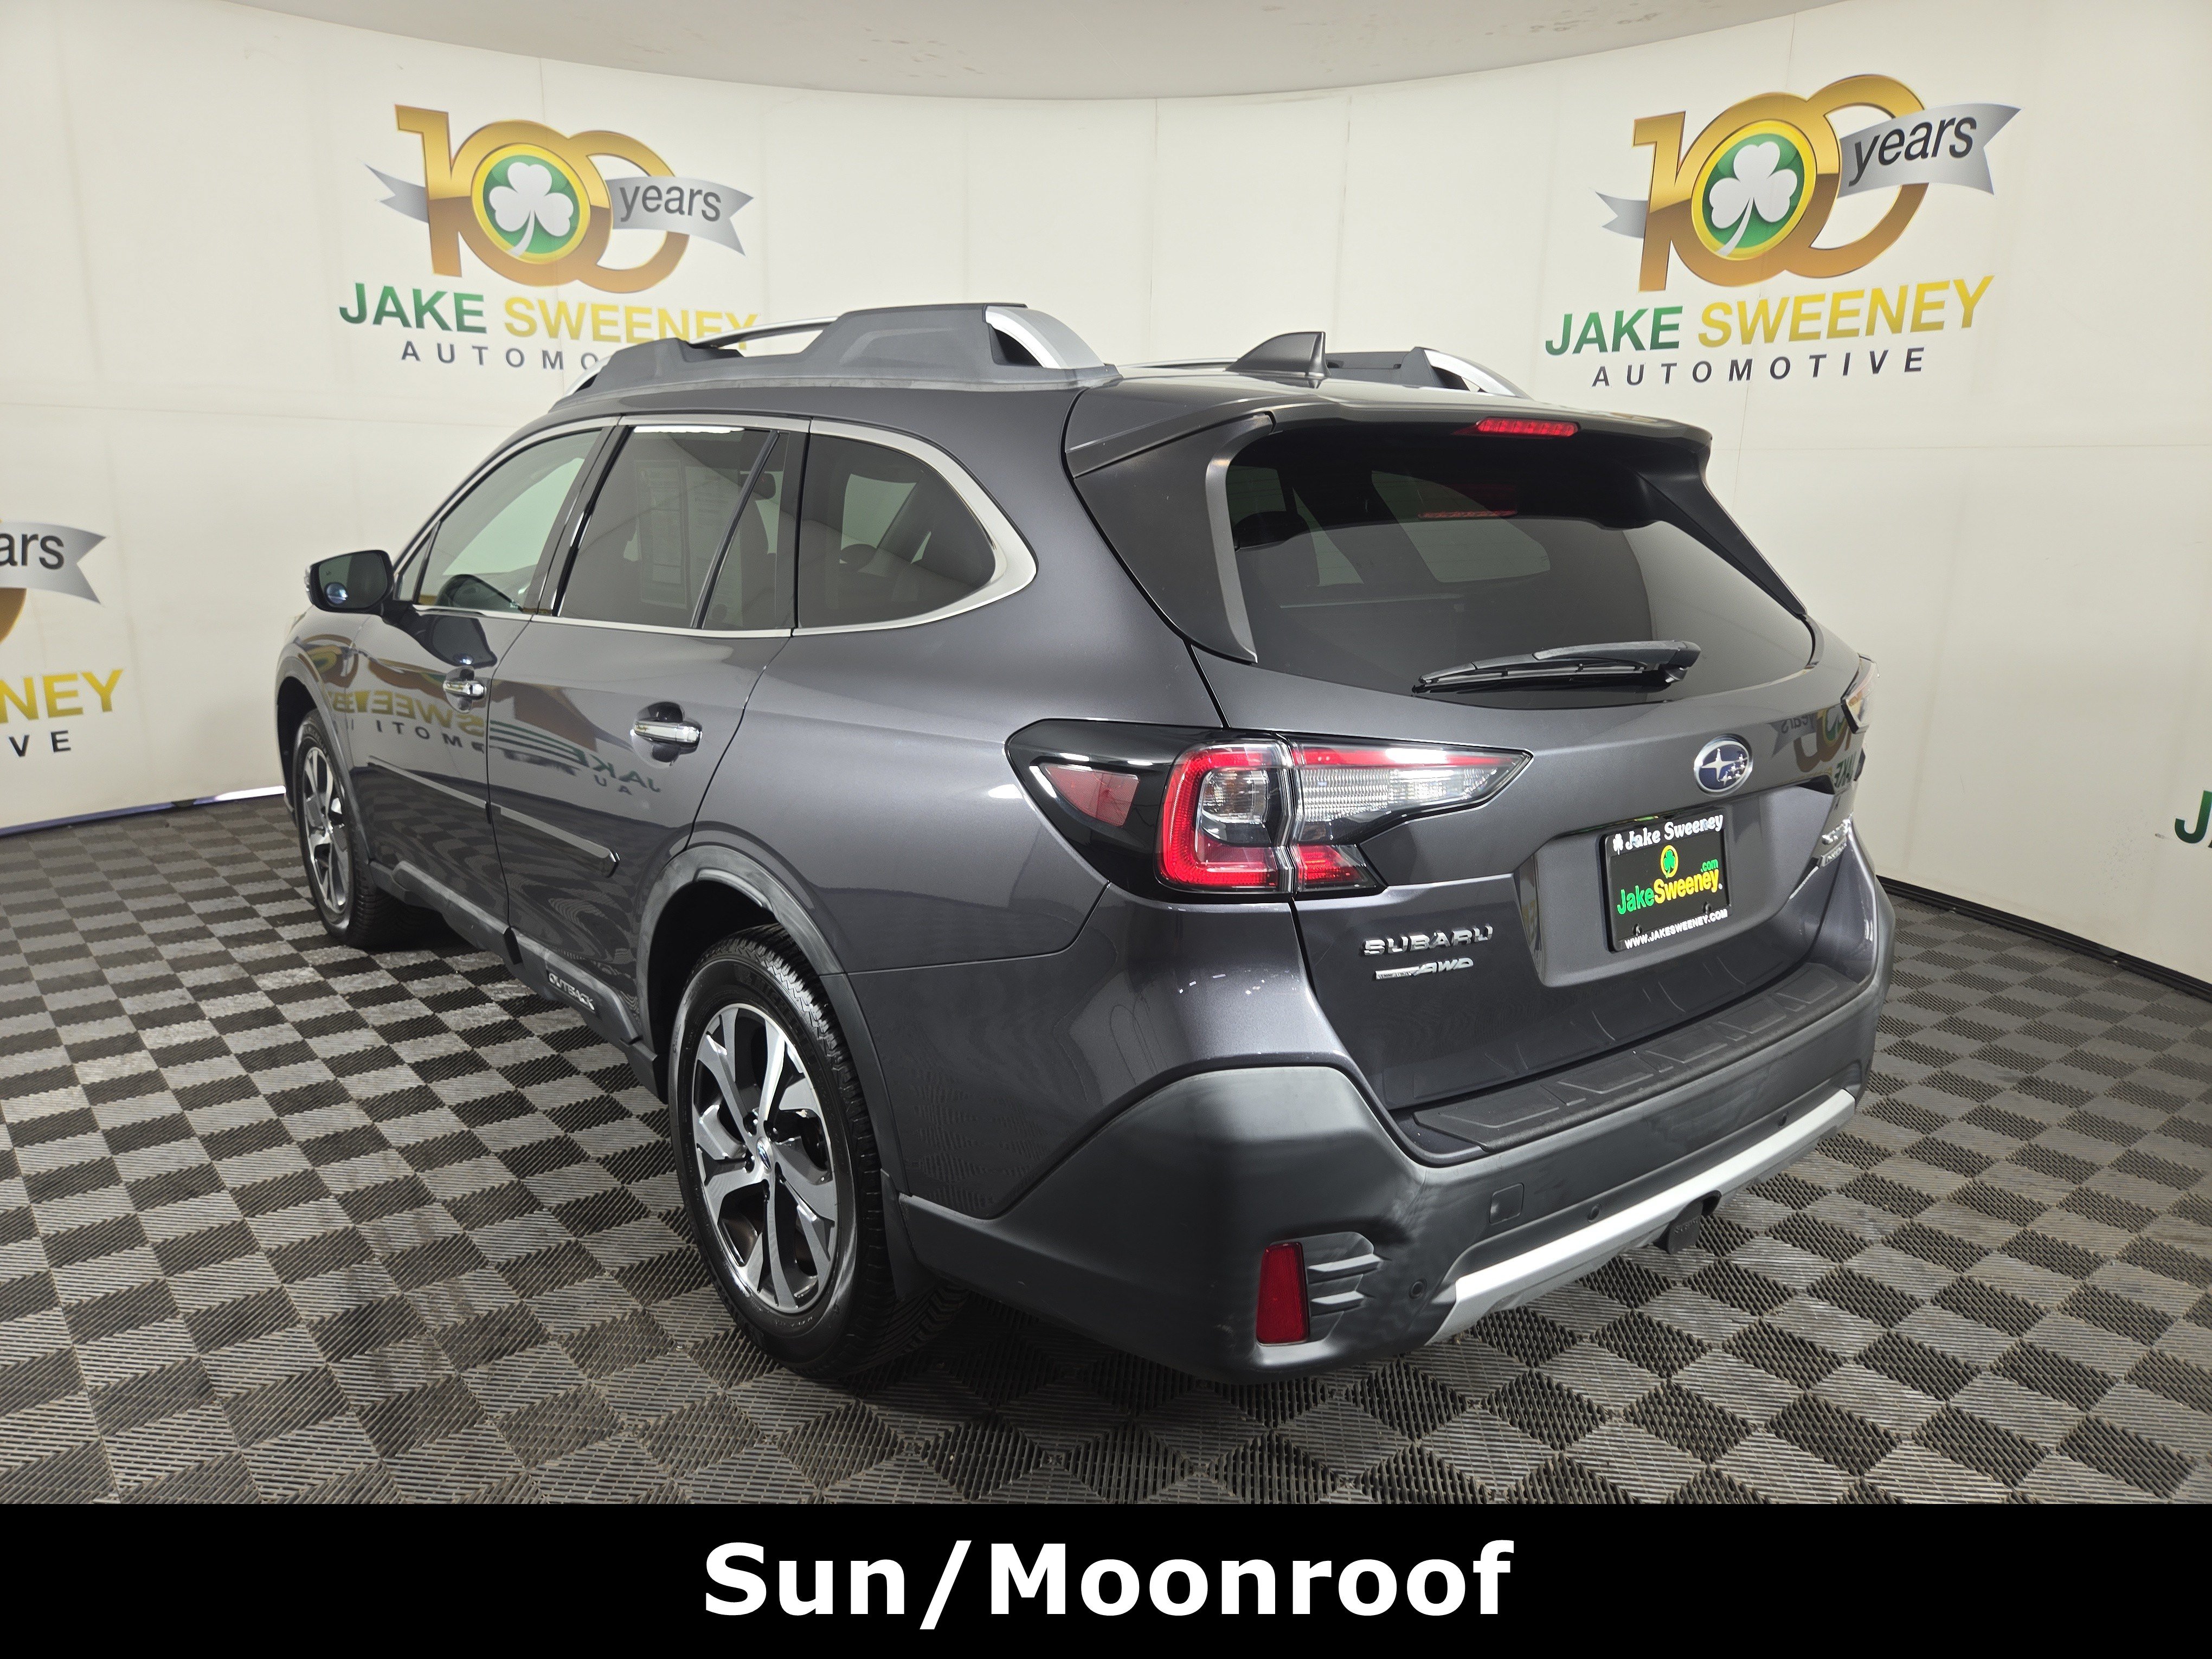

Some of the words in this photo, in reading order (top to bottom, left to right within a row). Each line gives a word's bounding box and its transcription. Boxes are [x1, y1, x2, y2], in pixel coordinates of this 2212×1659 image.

[1848, 117, 1977, 187] years
[620, 184, 722, 223] years
[339, 282, 487, 334] JAKE
[504, 296, 758, 351] SWEENEY
[1545, 305, 1683, 356] JAKE
[1698, 275, 1995, 348] SWEENEY
[401, 340, 599, 371] AUTOMO
[1592, 346, 1926, 388] AUTOMOTIVE
[1625, 827, 1661, 850] Jake
[1664, 815, 1724, 840] Sweeney
[1364, 923, 1493, 955] SUBARU
[1624, 909, 1728, 949] WWW.JAKESWEENEY.COM
[1412, 957, 1474, 976] AWD
[549, 973, 595, 1011] OUTBACK
